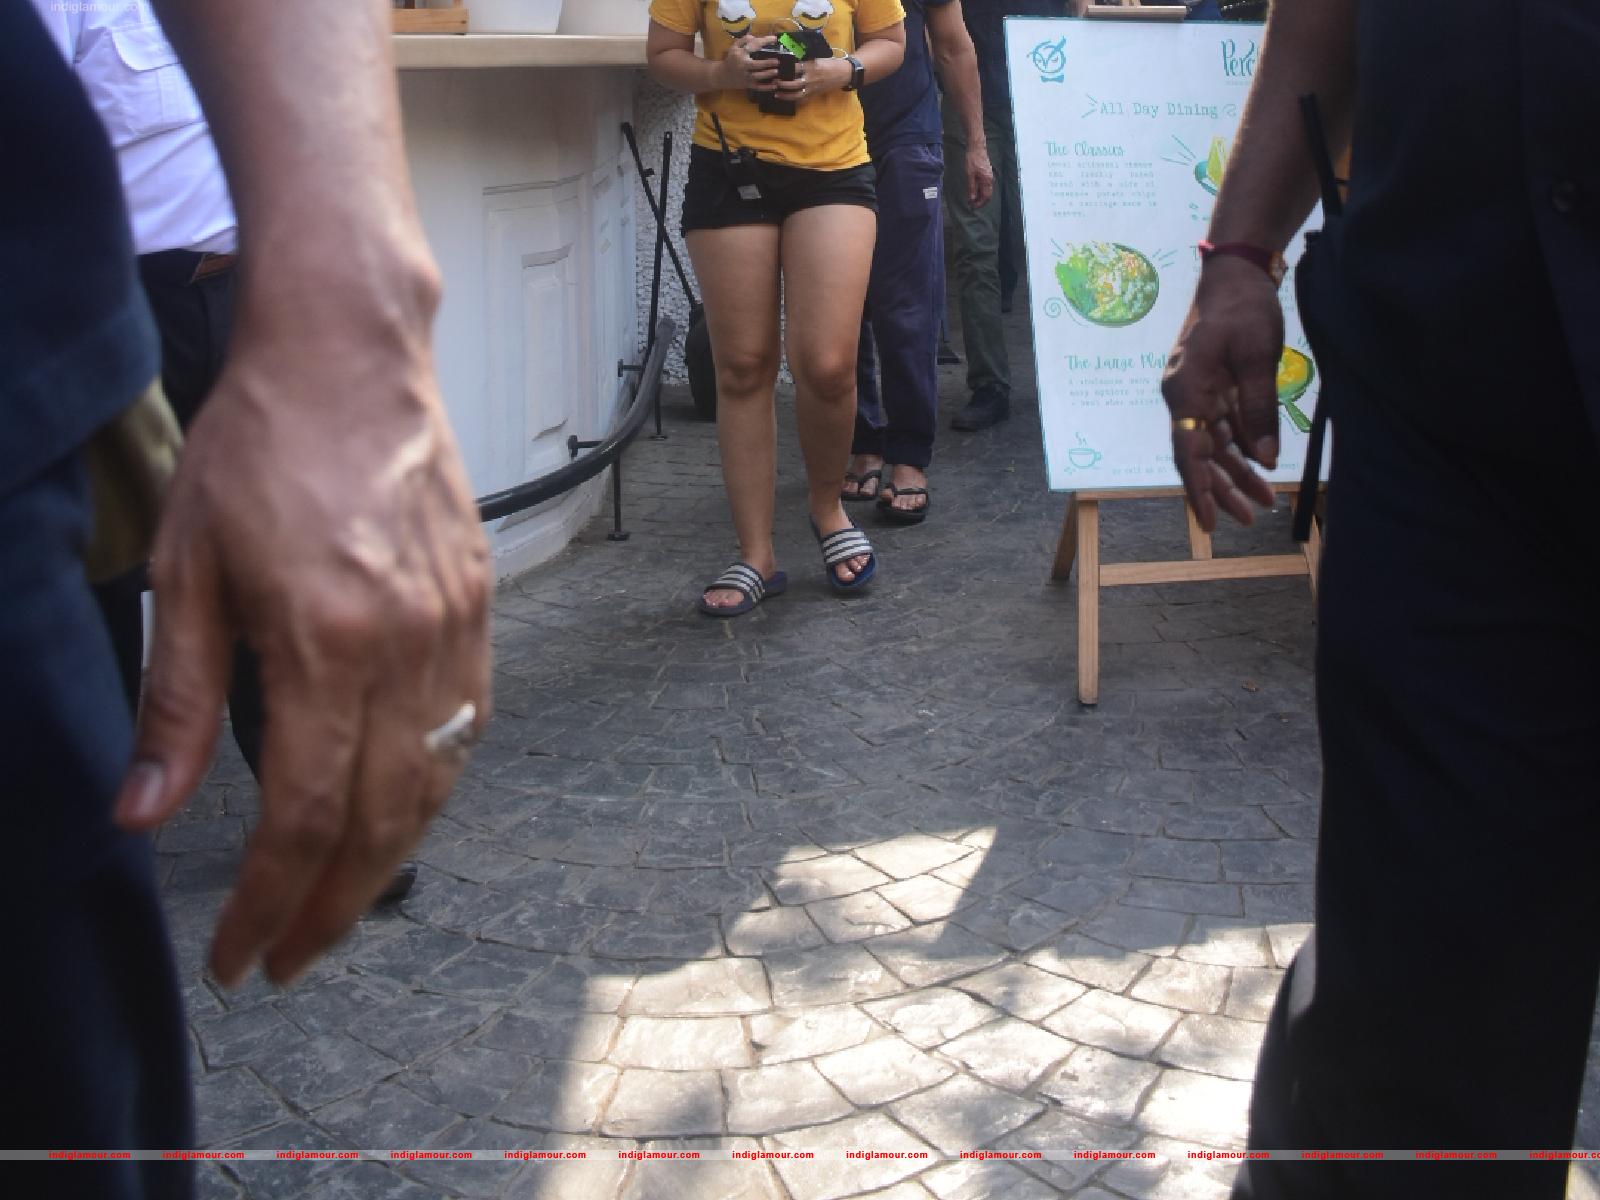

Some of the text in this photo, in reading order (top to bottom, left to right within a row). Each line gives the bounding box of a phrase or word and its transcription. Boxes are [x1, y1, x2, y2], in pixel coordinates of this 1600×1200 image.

[1100, 102, 1218, 119] All Day Dining
[1044, 140, 1068, 157] The
[1064, 352, 1167, 371] The Large Plat
